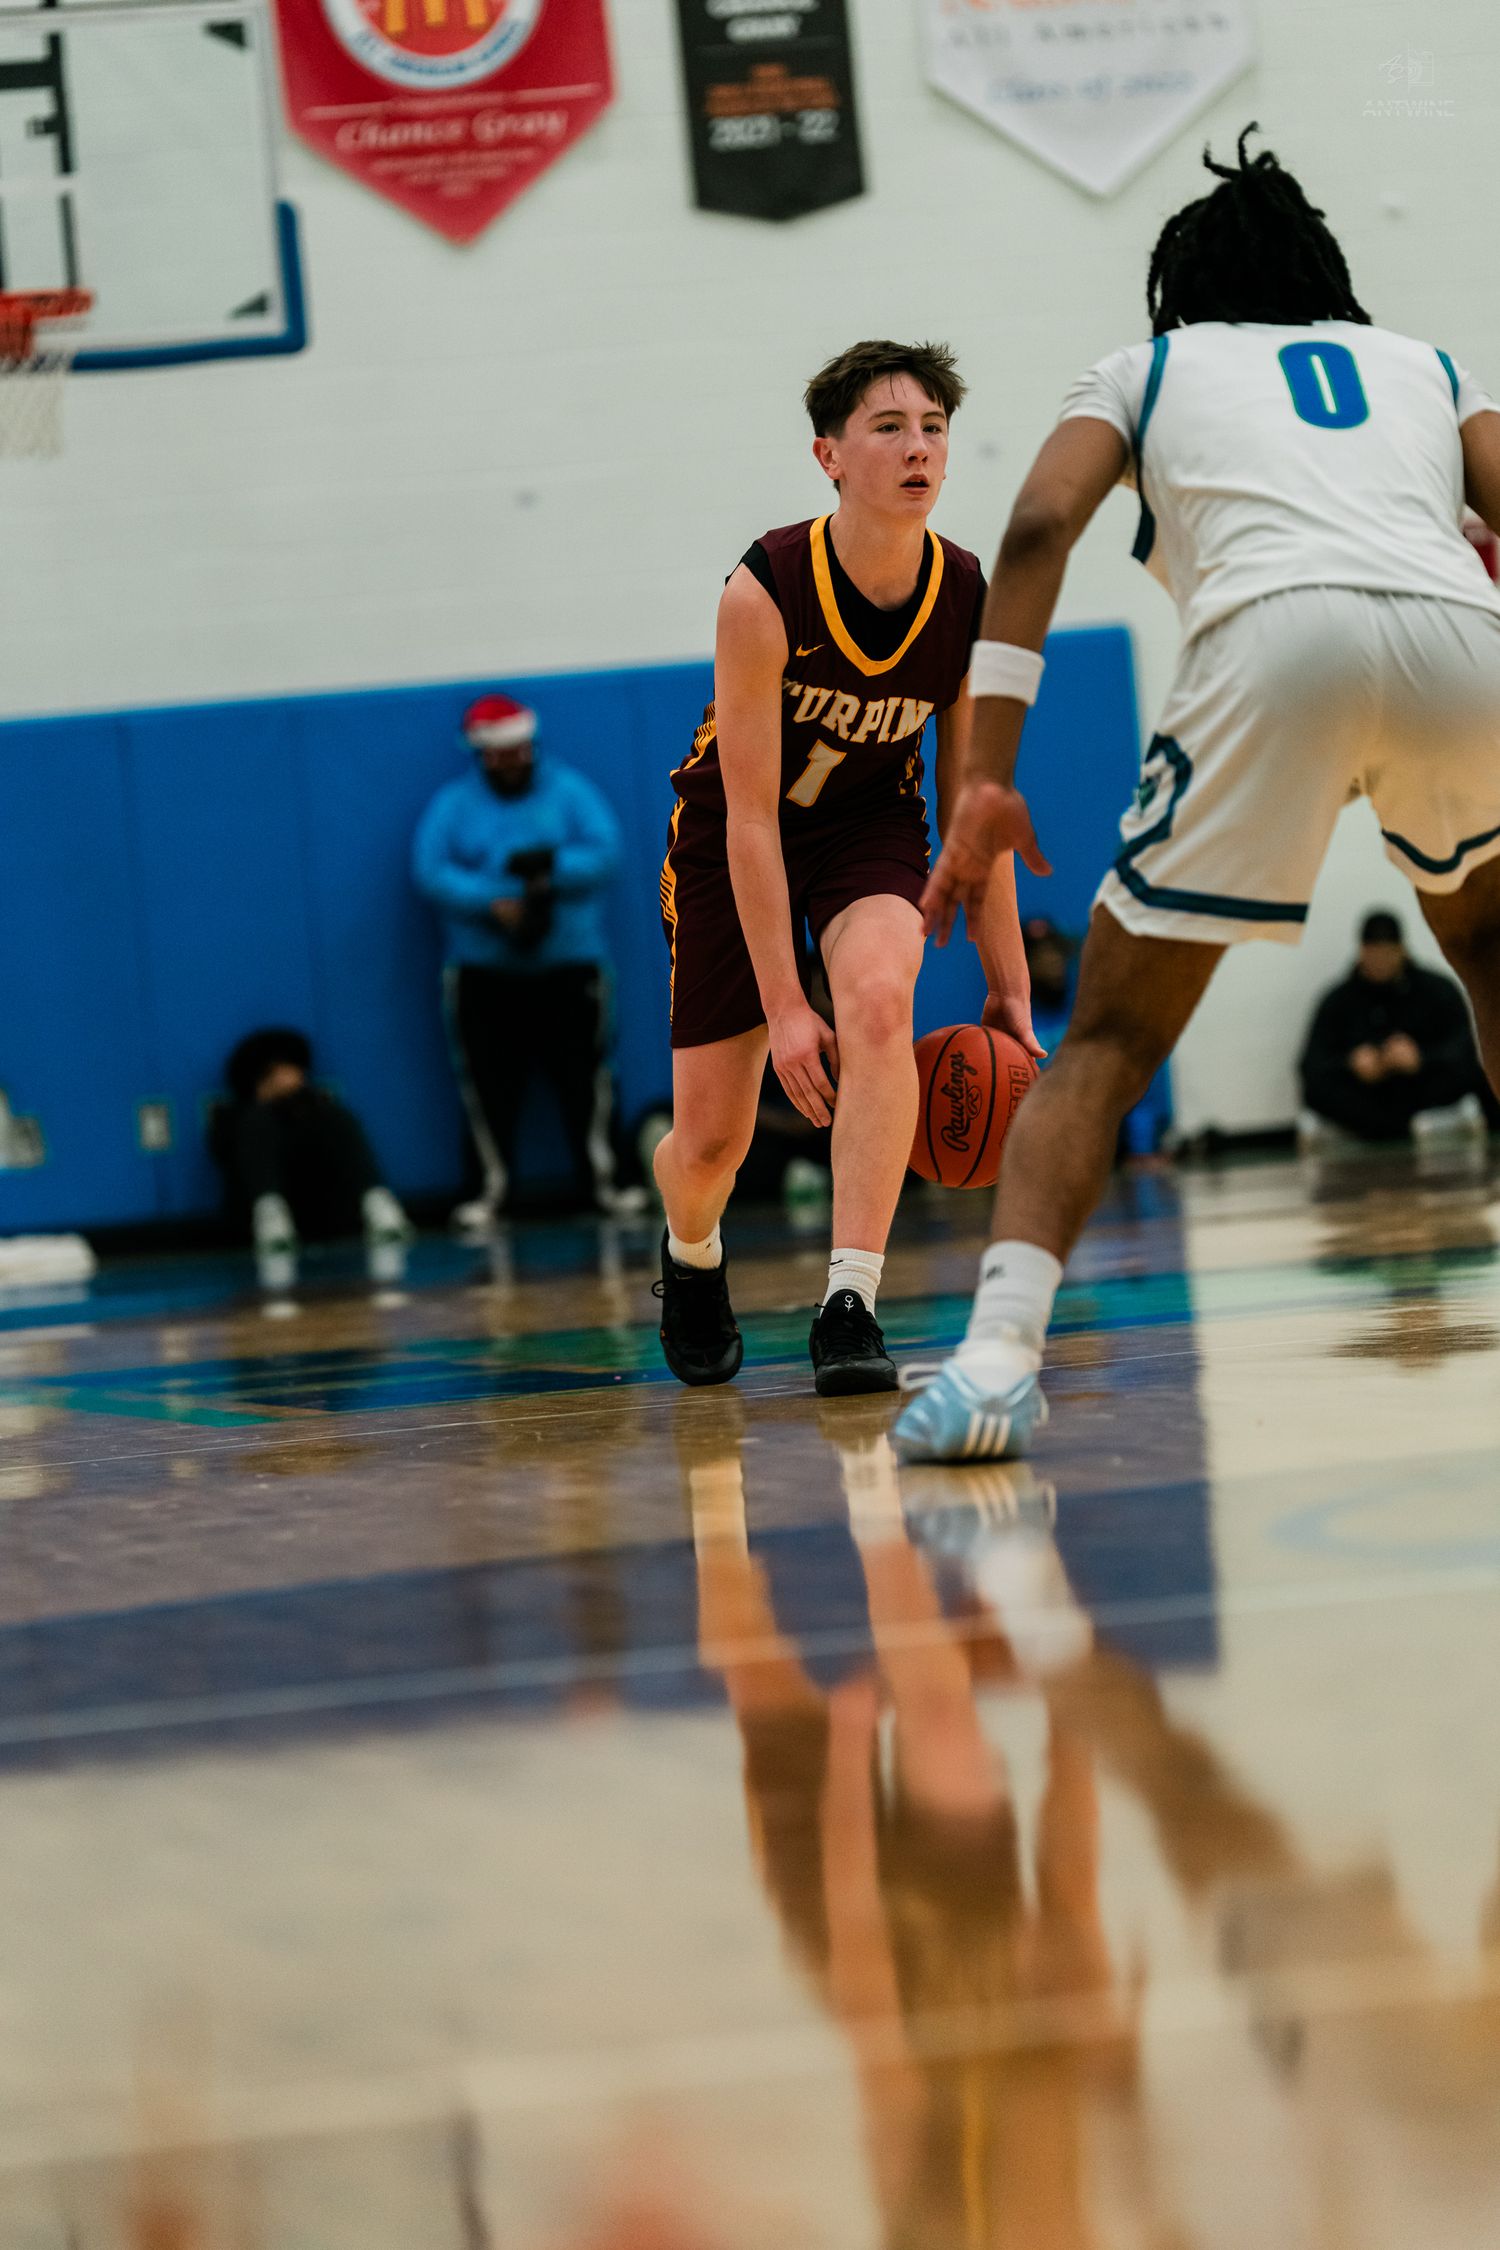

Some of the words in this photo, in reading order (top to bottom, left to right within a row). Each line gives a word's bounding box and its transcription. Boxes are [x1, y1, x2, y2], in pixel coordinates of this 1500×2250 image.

[1278, 341, 1370, 429] 0
[785, 738, 847, 807] 1
[941, 1051, 978, 1152] Rawlings
